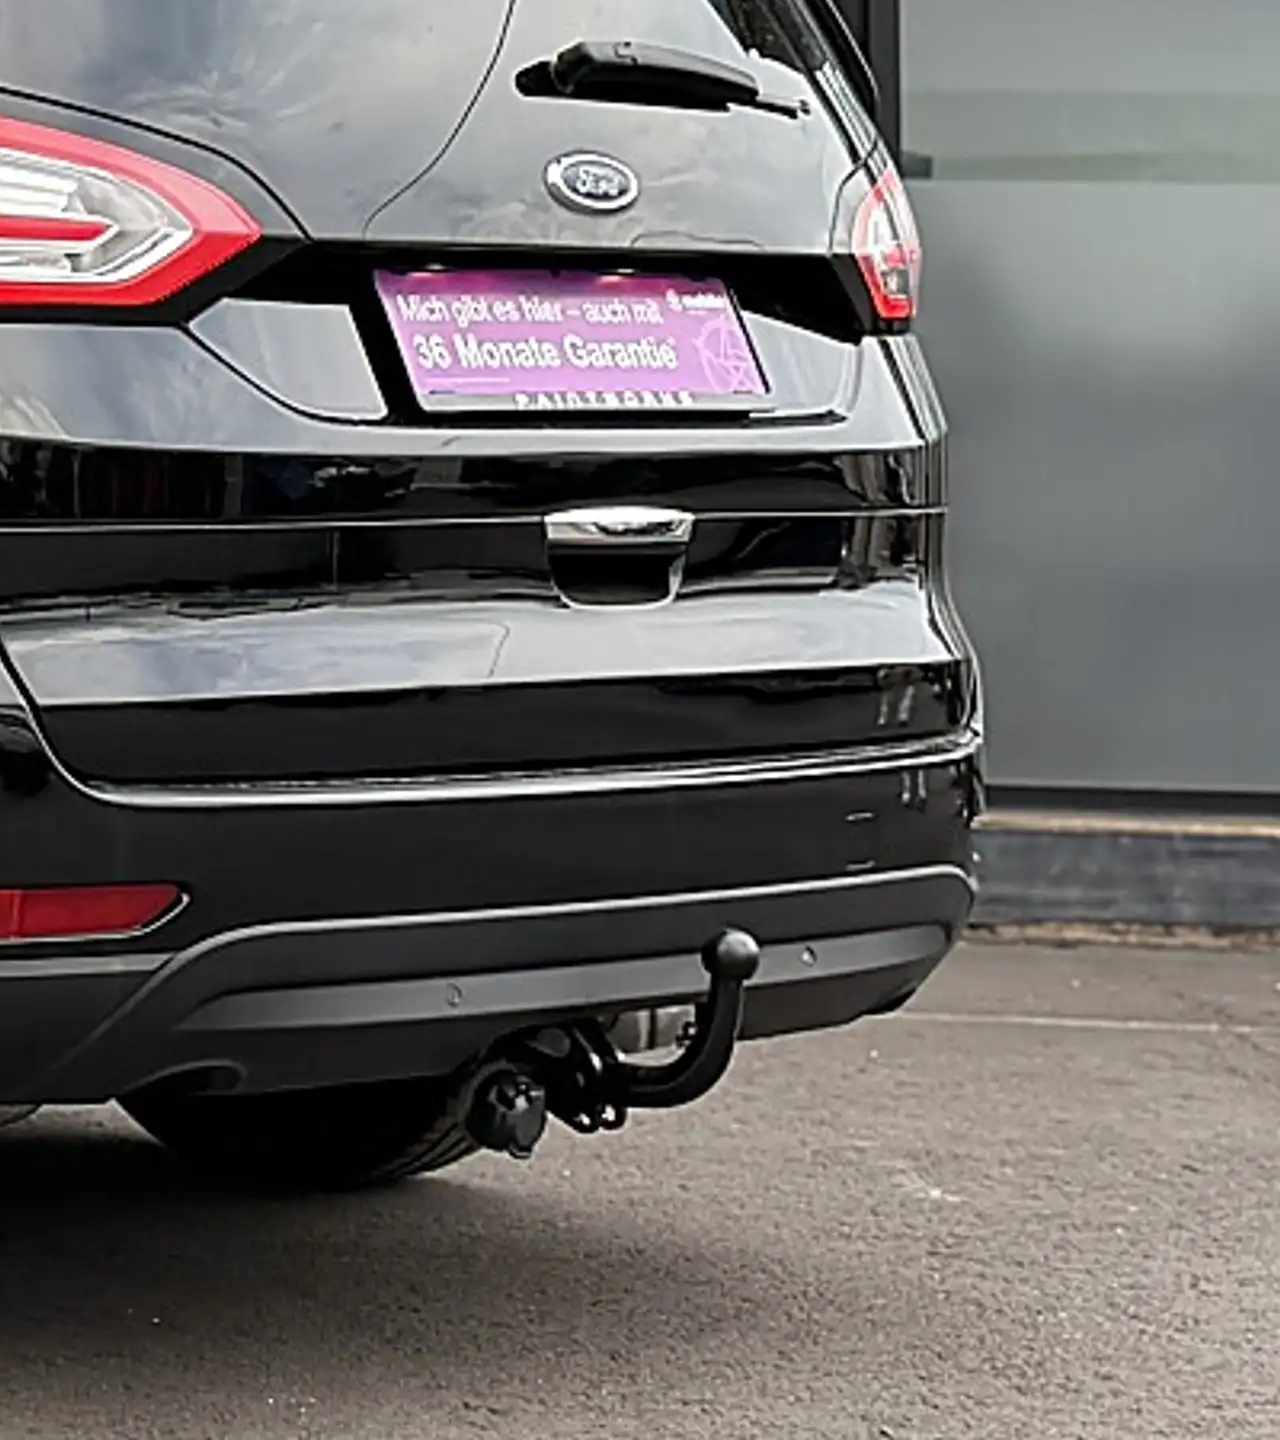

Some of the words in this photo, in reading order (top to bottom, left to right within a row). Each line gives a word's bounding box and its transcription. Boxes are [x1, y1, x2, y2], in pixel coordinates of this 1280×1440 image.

[396, 294, 450, 322] Mich
[451, 294, 491, 328] gibt
[493, 298, 520, 322] es
[520, 295, 563, 323] hier
[582, 298, 632, 325] auch
[635, 299, 665, 325] mit
[412, 334, 451, 370] 36
[452, 332, 563, 369] Monate
